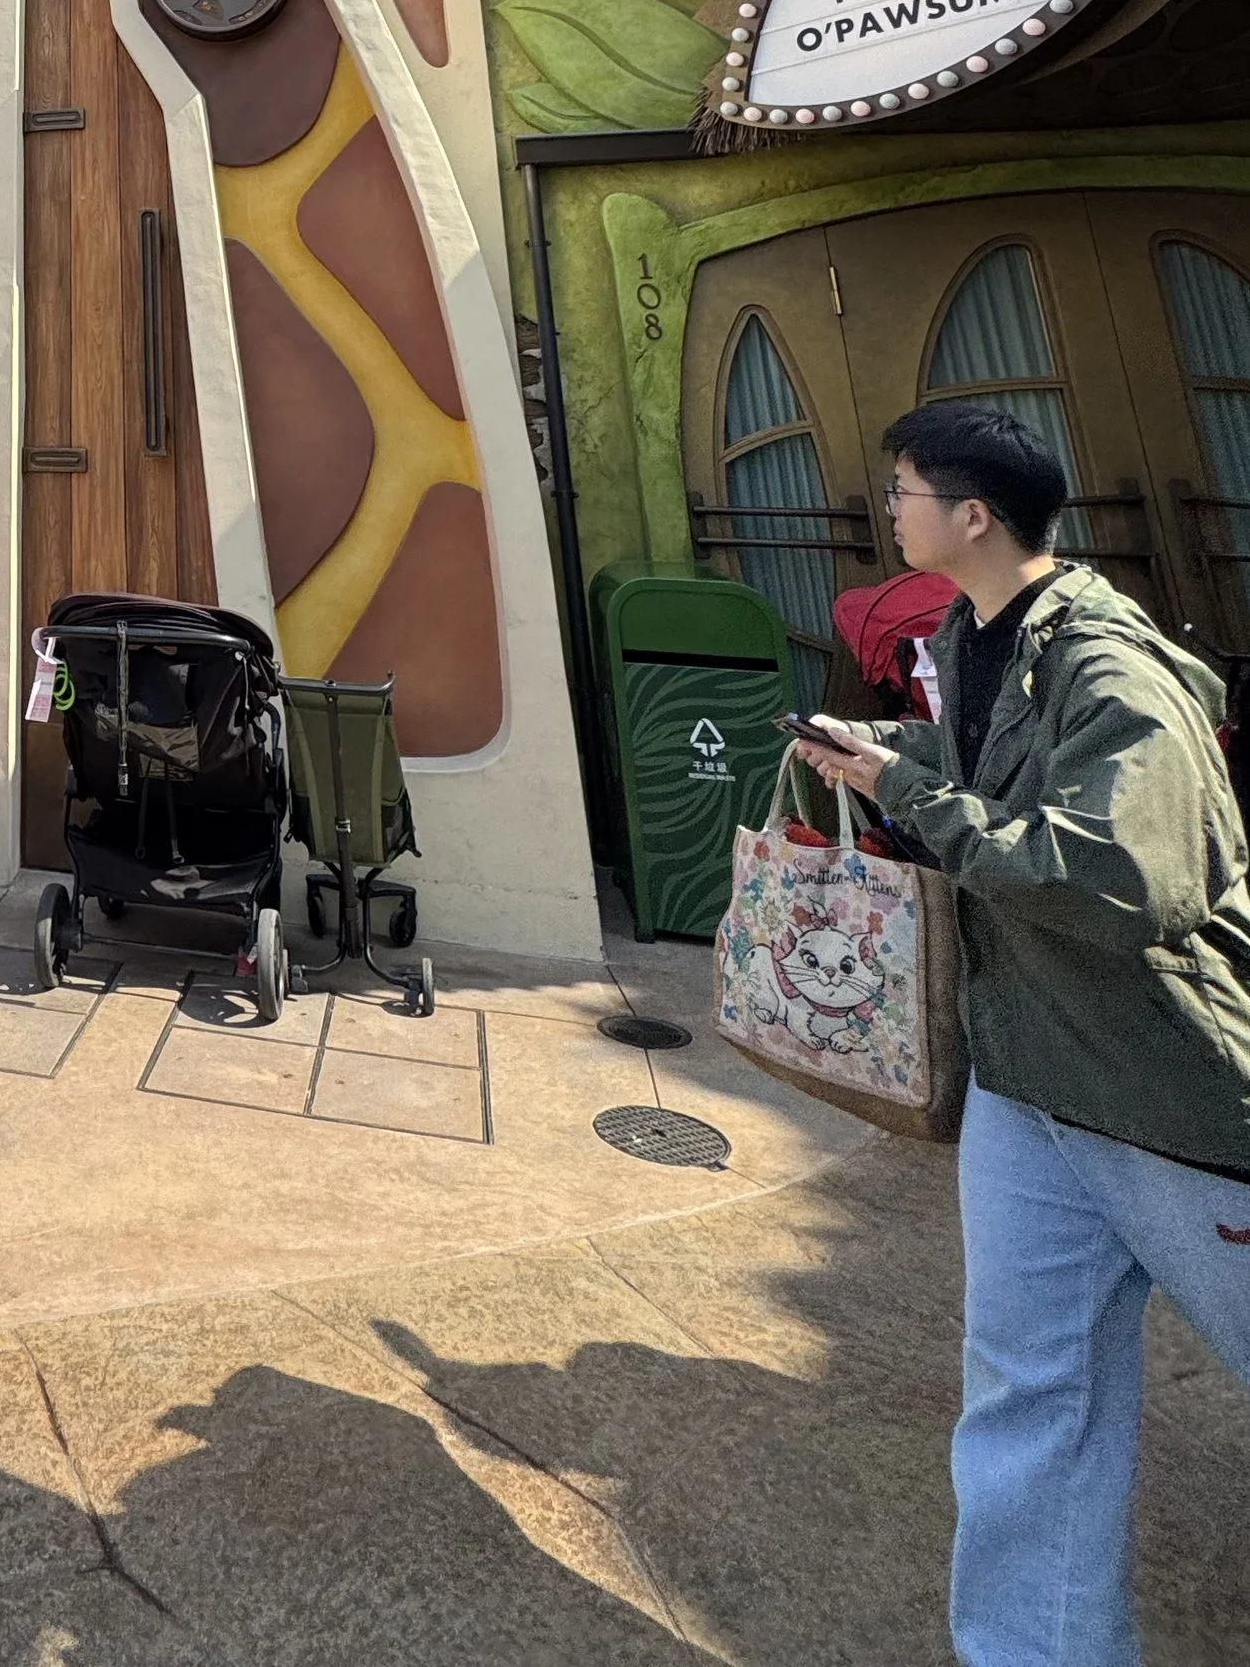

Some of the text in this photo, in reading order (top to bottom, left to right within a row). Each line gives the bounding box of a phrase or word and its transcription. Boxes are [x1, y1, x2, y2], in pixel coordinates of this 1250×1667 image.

[637, 253, 663, 341] 108
[692, 760, 728, 773] 干垃圾
